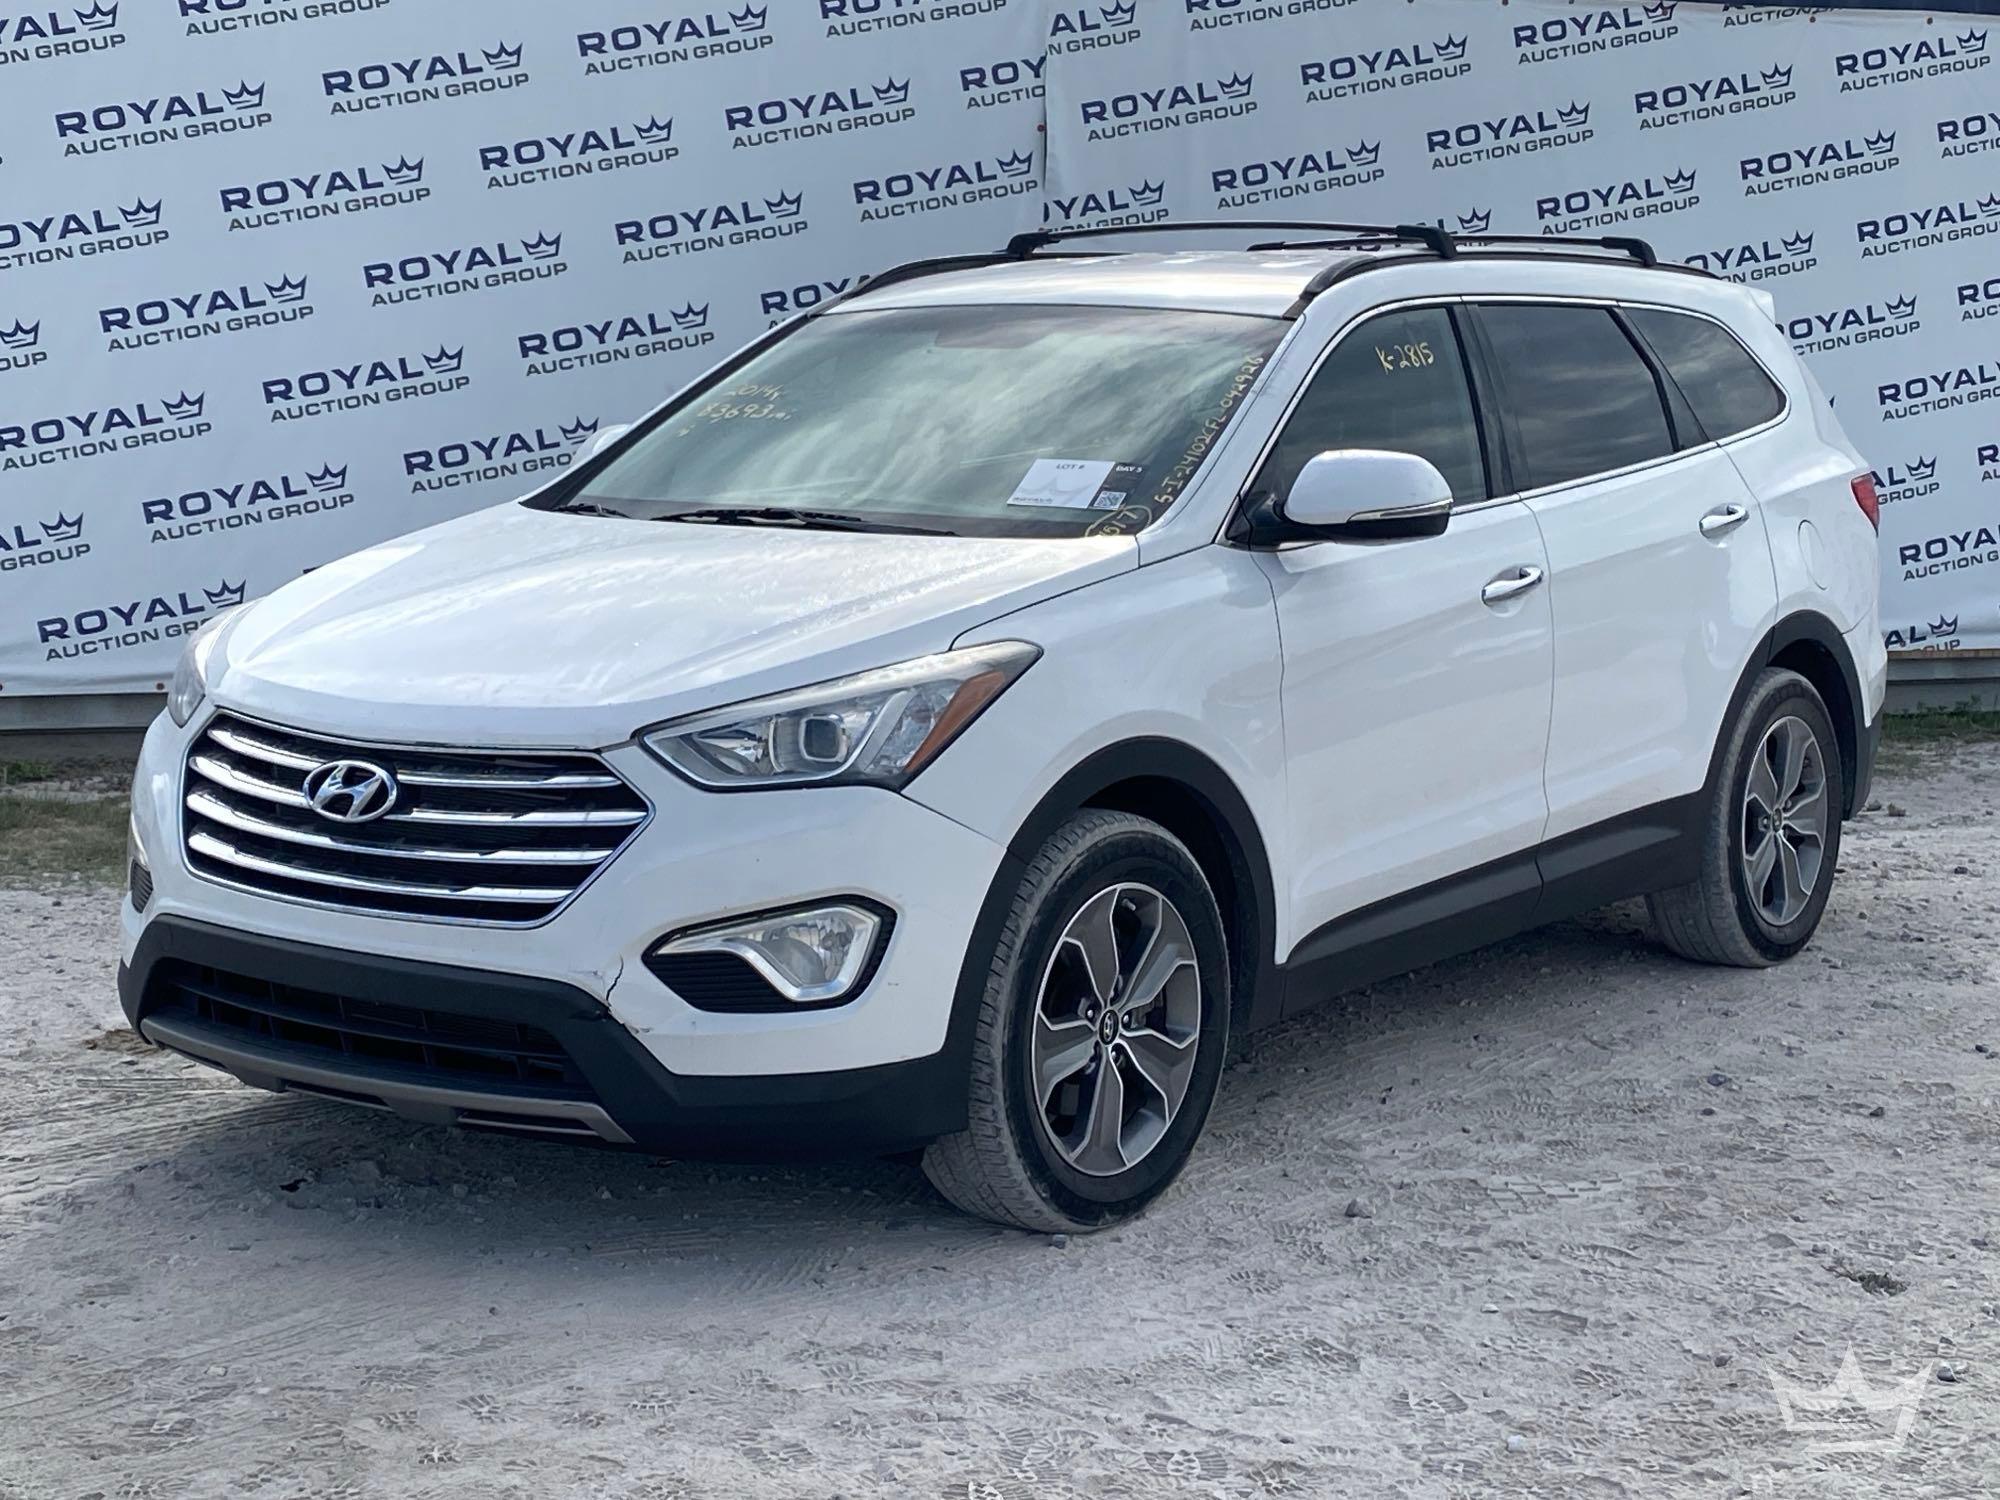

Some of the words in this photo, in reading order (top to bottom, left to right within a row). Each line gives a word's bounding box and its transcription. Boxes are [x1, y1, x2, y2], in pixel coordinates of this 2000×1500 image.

[186, 8, 298, 36] AUCTION
[577, 14, 731, 57] ROYAL
[826, 10, 926, 38] AUCTION
[1190, 5, 1283, 31] AUCTION
[1513, 8, 1643, 48] ROYAL
[35, 33, 126, 59] GROUP
[585, 48, 688, 75] AUCTION
[693, 35, 773, 59] GROUP
[1066, 30, 1141, 52] GROUP
[1519, 38, 1606, 65] AUCTION
[1610, 26, 1678, 48] GROUP
[1836, 37, 1957, 76] ROYAL
[322, 52, 484, 96] ROYAL
[960, 56, 1046, 91] ROY
[1300, 45, 1434, 85] ROYAL
[1306, 76, 1396, 103] AUCTION
[1400, 63, 1471, 86] GROUP
[1840, 67, 1923, 93] AUCTION
[1927, 56, 1990, 76] GROUP
[331, 86, 439, 115] AUCTION
[444, 73, 529, 97] GROUP
[725, 88, 874, 131] ROYAL
[967, 85, 1046, 109] AUCTIO
[1081, 82, 1219, 124] ROYAL
[1635, 73, 1761, 114] ROYAL
[1640, 104, 1725, 130] AUCTION
[1729, 91, 1796, 113] GROUP
[55, 92, 225, 140] ROYAL
[64, 127, 178, 157] AUCTION
[183, 113, 272, 138] GROUP
[733, 121, 832, 149] AUCTION
[837, 108, 915, 131] GROUP
[1088, 115, 1180, 142] AUCTION
[1185, 101, 1257, 124] GROUP
[1426, 111, 1558, 153] ROYAL
[479, 127, 636, 171] ROYAL
[488, 160, 593, 189] AUCTION
[597, 147, 679, 171] GROUP
[1432, 142, 1520, 170] AUCTION
[1524, 129, 1593, 152] GROUP
[1740, 140, 1864, 181] ROYAL
[220, 167, 384, 213] ROYAL
[853, 161, 997, 204] ROYAL
[1212, 151, 1347, 192] ROYAL
[1218, 182, 1310, 210] AUCTION
[1314, 169, 1384, 191] GROUP
[1745, 170, 1829, 197] AUCTION
[1833, 157, 1899, 179] GROUP
[229, 201, 340, 231] AUCTION
[344, 188, 431, 212] GROUP
[860, 194, 958, 222] AUCTION
[962, 180, 1038, 203] GROUP
[1043, 190, 1130, 224] YAL
[1537, 179, 1664, 220] ROYAL
[1542, 209, 1629, 235] AUCTION
[1632, 196, 1700, 219] GROUP
[0, 210, 121, 250] OYAL
[615, 201, 766, 245] ROYAL
[623, 235, 724, 264] AUCTION
[729, 221, 808, 245] GROUP
[1857, 202, 1978, 242] ROYAL
[1861, 231, 1943, 259] AUCTION
[1948, 221, 2000, 241] GROU
[0, 245, 74, 270] CTION
[79, 230, 169, 256] GROUP
[363, 243, 523, 288] ROYAL
[1685, 241, 1782, 271] OYAL
[1750, 257, 1817, 281] GROUP
[372, 277, 479, 307] AUCTION
[484, 262, 568, 287] GROUP
[99, 286, 267, 333] ROYAL
[108, 321, 221, 352] AUCTION
[226, 306, 313, 331] GROUP
[1775, 305, 1886, 340] OYAL
[518, 313, 672, 358] ROYAL
[526, 347, 630, 376] AUCTION
[635, 332, 714, 357] GROUP
[1793, 335, 1850, 357] CTION
[1854, 321, 1920, 344] GROUP
[0, 351, 48, 372] OUP
[262, 357, 425, 404] ROYAL
[271, 392, 380, 423] AUCTION
[385, 376, 470, 401] GROUP
[1878, 365, 1997, 406] ROYAL
[1883, 394, 1963, 422] AUCTION
[1968, 385, 2000, 403] GRO
[0, 403, 165, 452] ROYAL
[2, 438, 118, 471] AUCTION
[122, 422, 212, 449] GROUP
[403, 429, 561, 476] ROYAL
[412, 462, 518, 494] AUCTION
[522, 452, 577, 476] GRO
[142, 476, 308, 524] ROYAL
[1877, 482, 1940, 505] GROUP
[151, 510, 263, 543] AUCTION
[267, 494, 354, 520] GROUP
[0, 544, 91, 571] GROUP
[1899, 524, 2000, 566] ROYA
[1904, 552, 1983, 581] AUCTION
[37, 592, 206, 643] ROYAL
[46, 628, 160, 661] AUCTION
